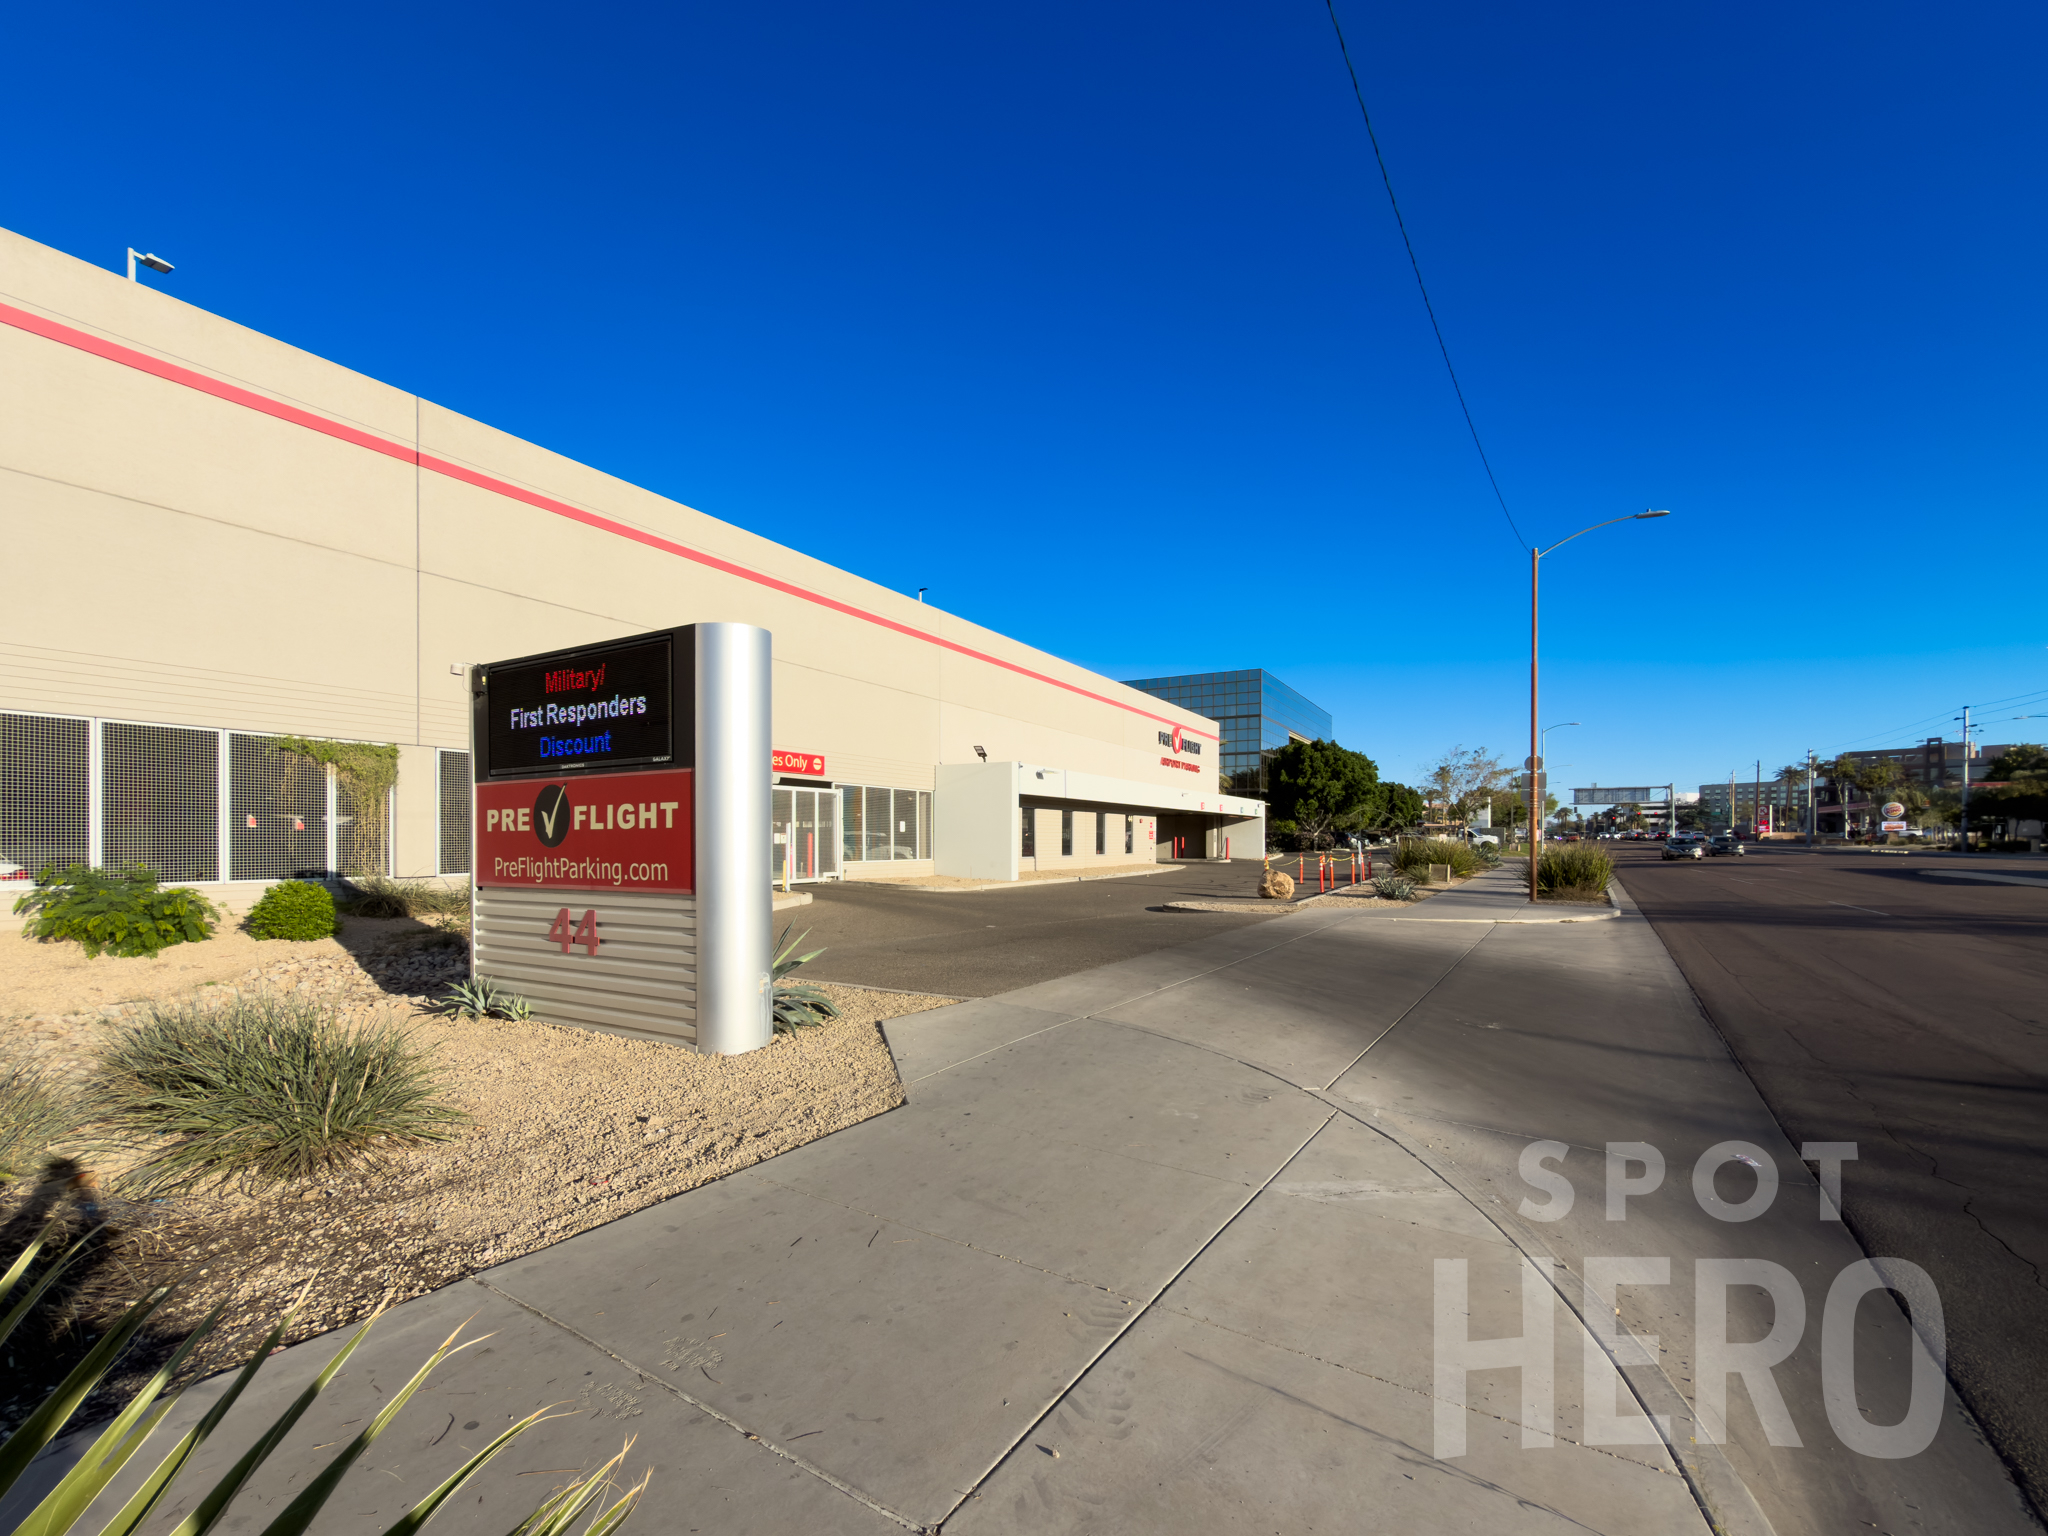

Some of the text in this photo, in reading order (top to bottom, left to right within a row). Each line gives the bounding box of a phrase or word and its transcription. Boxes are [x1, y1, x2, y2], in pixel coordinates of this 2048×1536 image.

[545, 663, 606, 693] Military/
[510, 694, 647, 729] First Responders
[539, 730, 611, 758] Discount
[1158, 731, 1202, 755] PRE FLIGHT
[785, 754, 808, 772] Only
[486, 801, 679, 832] PRE FLIGHT
[494, 856, 668, 885] PreFlightParking.com
[549, 908, 600, 956] 44
